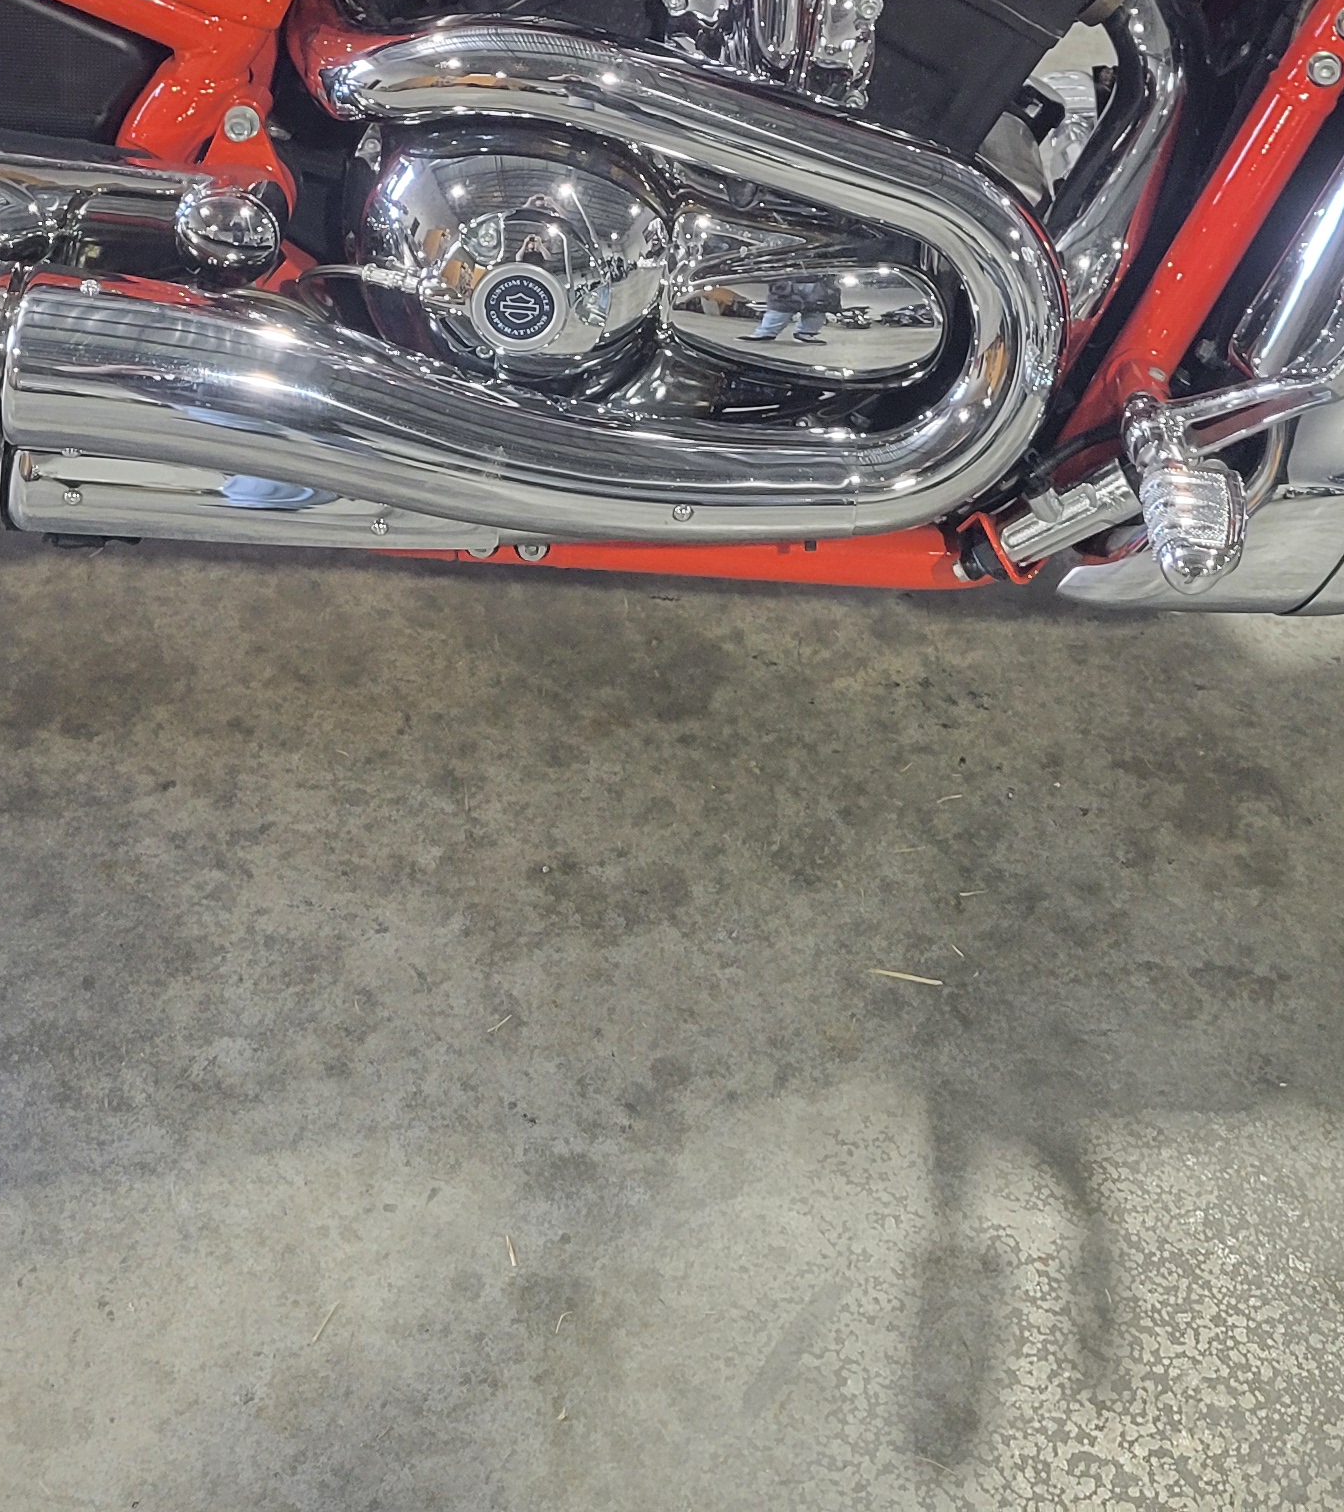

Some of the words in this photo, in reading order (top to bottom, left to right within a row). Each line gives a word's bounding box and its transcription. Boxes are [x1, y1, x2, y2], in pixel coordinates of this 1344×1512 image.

[489, 279, 521, 305] CUSTOM
[523, 279, 550, 312] VEHICLE
[489, 310, 548, 336] OPERATIONS
